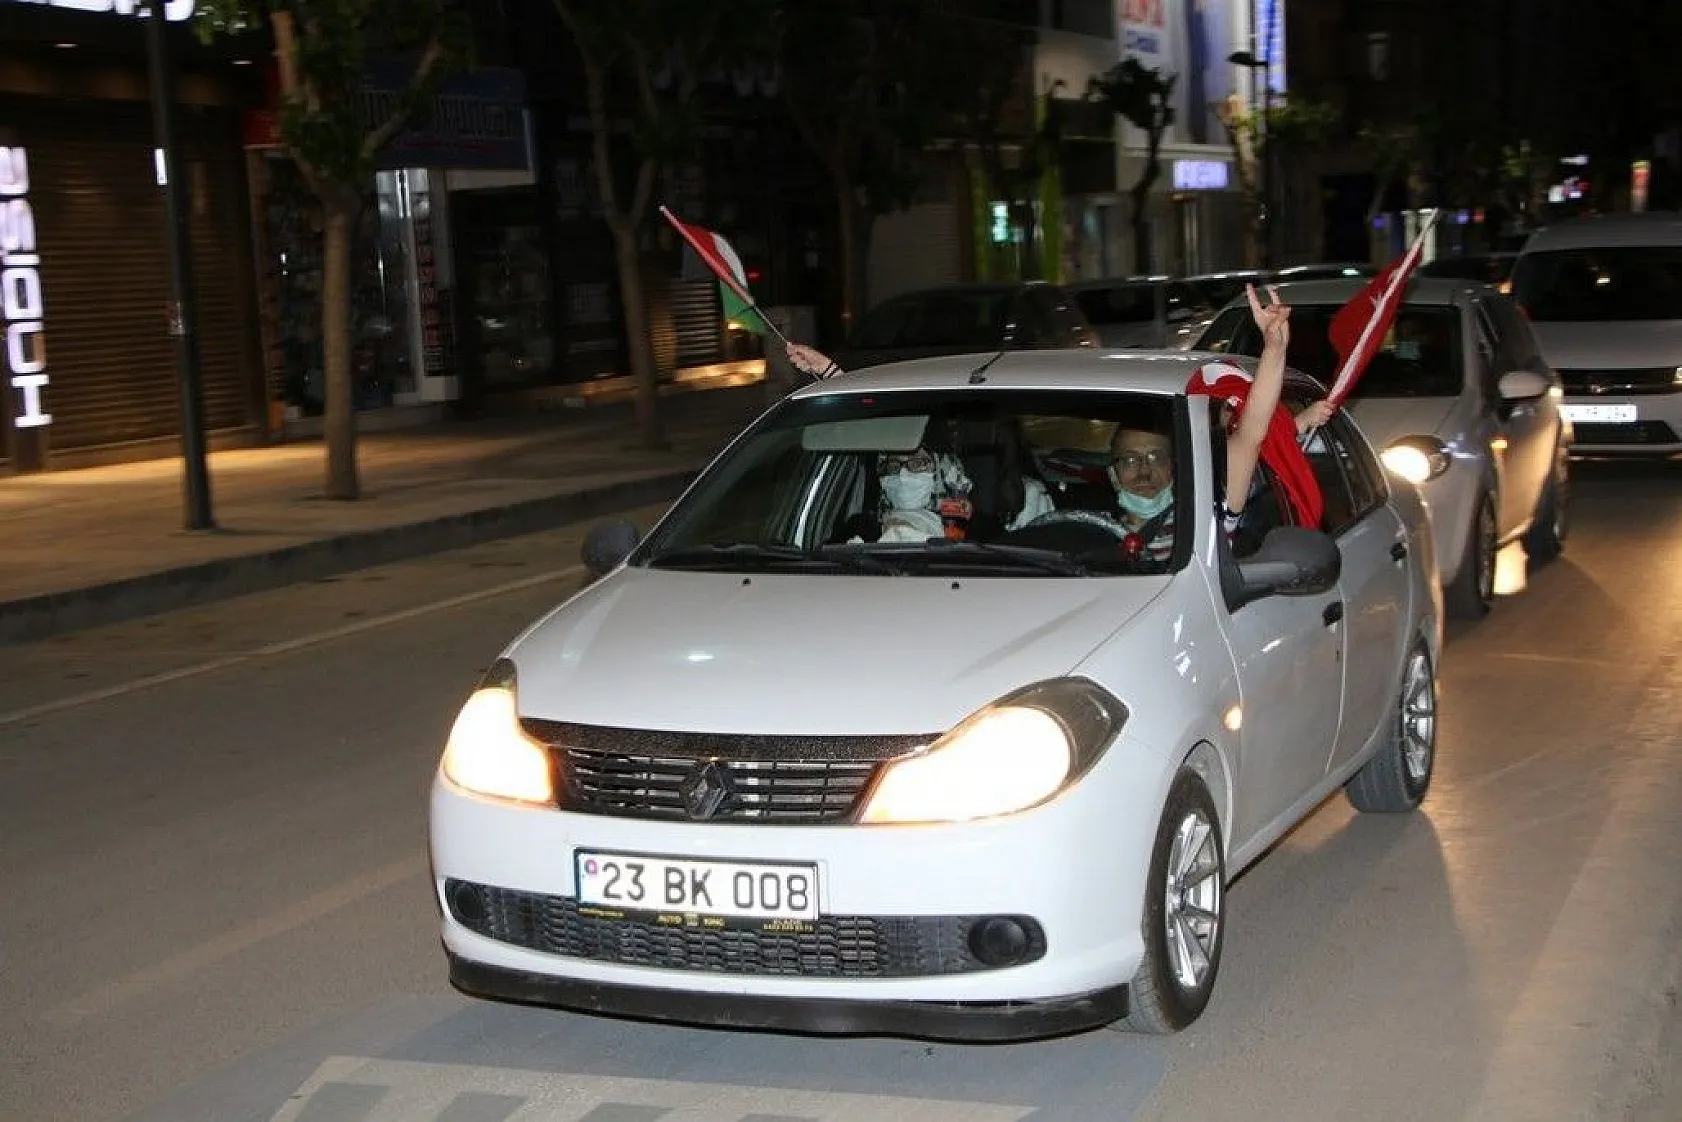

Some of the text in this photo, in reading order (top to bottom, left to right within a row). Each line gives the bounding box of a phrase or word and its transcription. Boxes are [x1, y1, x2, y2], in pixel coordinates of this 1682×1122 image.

[602, 861, 808, 911] 23 BK 008
